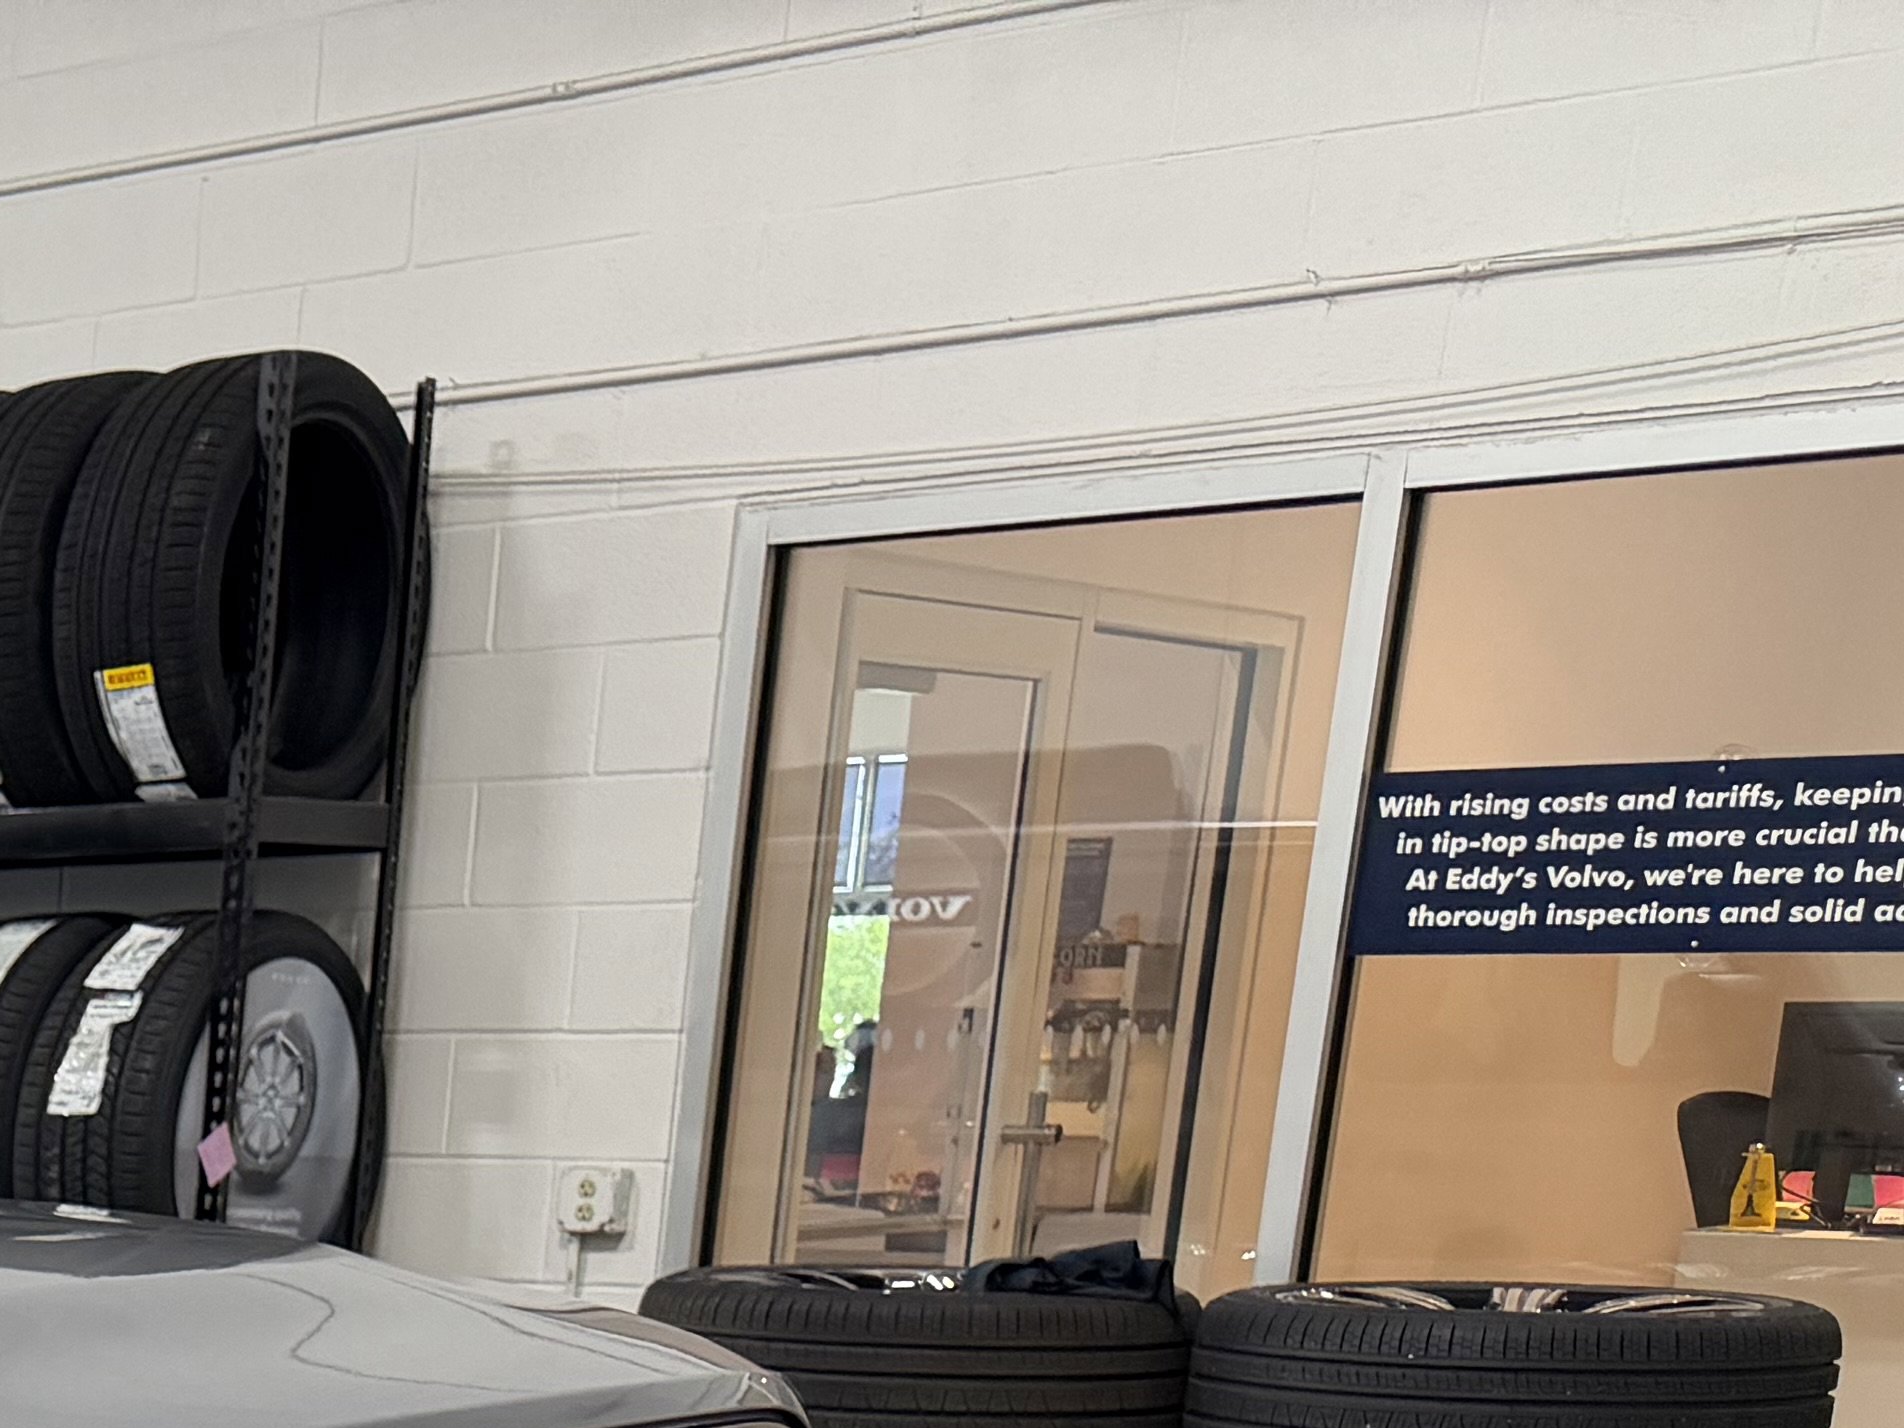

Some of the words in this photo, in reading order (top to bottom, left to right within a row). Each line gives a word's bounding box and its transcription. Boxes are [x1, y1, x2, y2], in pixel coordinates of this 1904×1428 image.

[1379, 794, 1441, 818] With
[1449, 793, 1530, 820] rising
[1538, 792, 1609, 814] costs
[1617, 786, 1677, 811] and
[1685, 783, 1784, 811] tariffs,
[1794, 780, 1904, 810] keepin
[1396, 832, 1423, 854] in
[1432, 830, 1528, 858] tip-top
[1535, 827, 1625, 856] shape
[1634, 825, 1658, 848] is
[1667, 829, 1746, 848] more
[1755, 820, 1858, 846] crucial
[1405, 868, 1438, 891] At
[1445, 866, 1538, 895] Eddy's
[1546, 864, 1634, 891] Volvo,
[1644, 864, 1724, 886] we're
[1732, 861, 1804, 885] here
[1813, 862, 1844, 883] to
[1854, 858, 1904, 887] hel
[1408, 902, 1537, 931] thorough
[1546, 900, 1711, 931] inspections
[1719, 899, 1781, 924] and
[1788, 898, 1865, 923] solid
